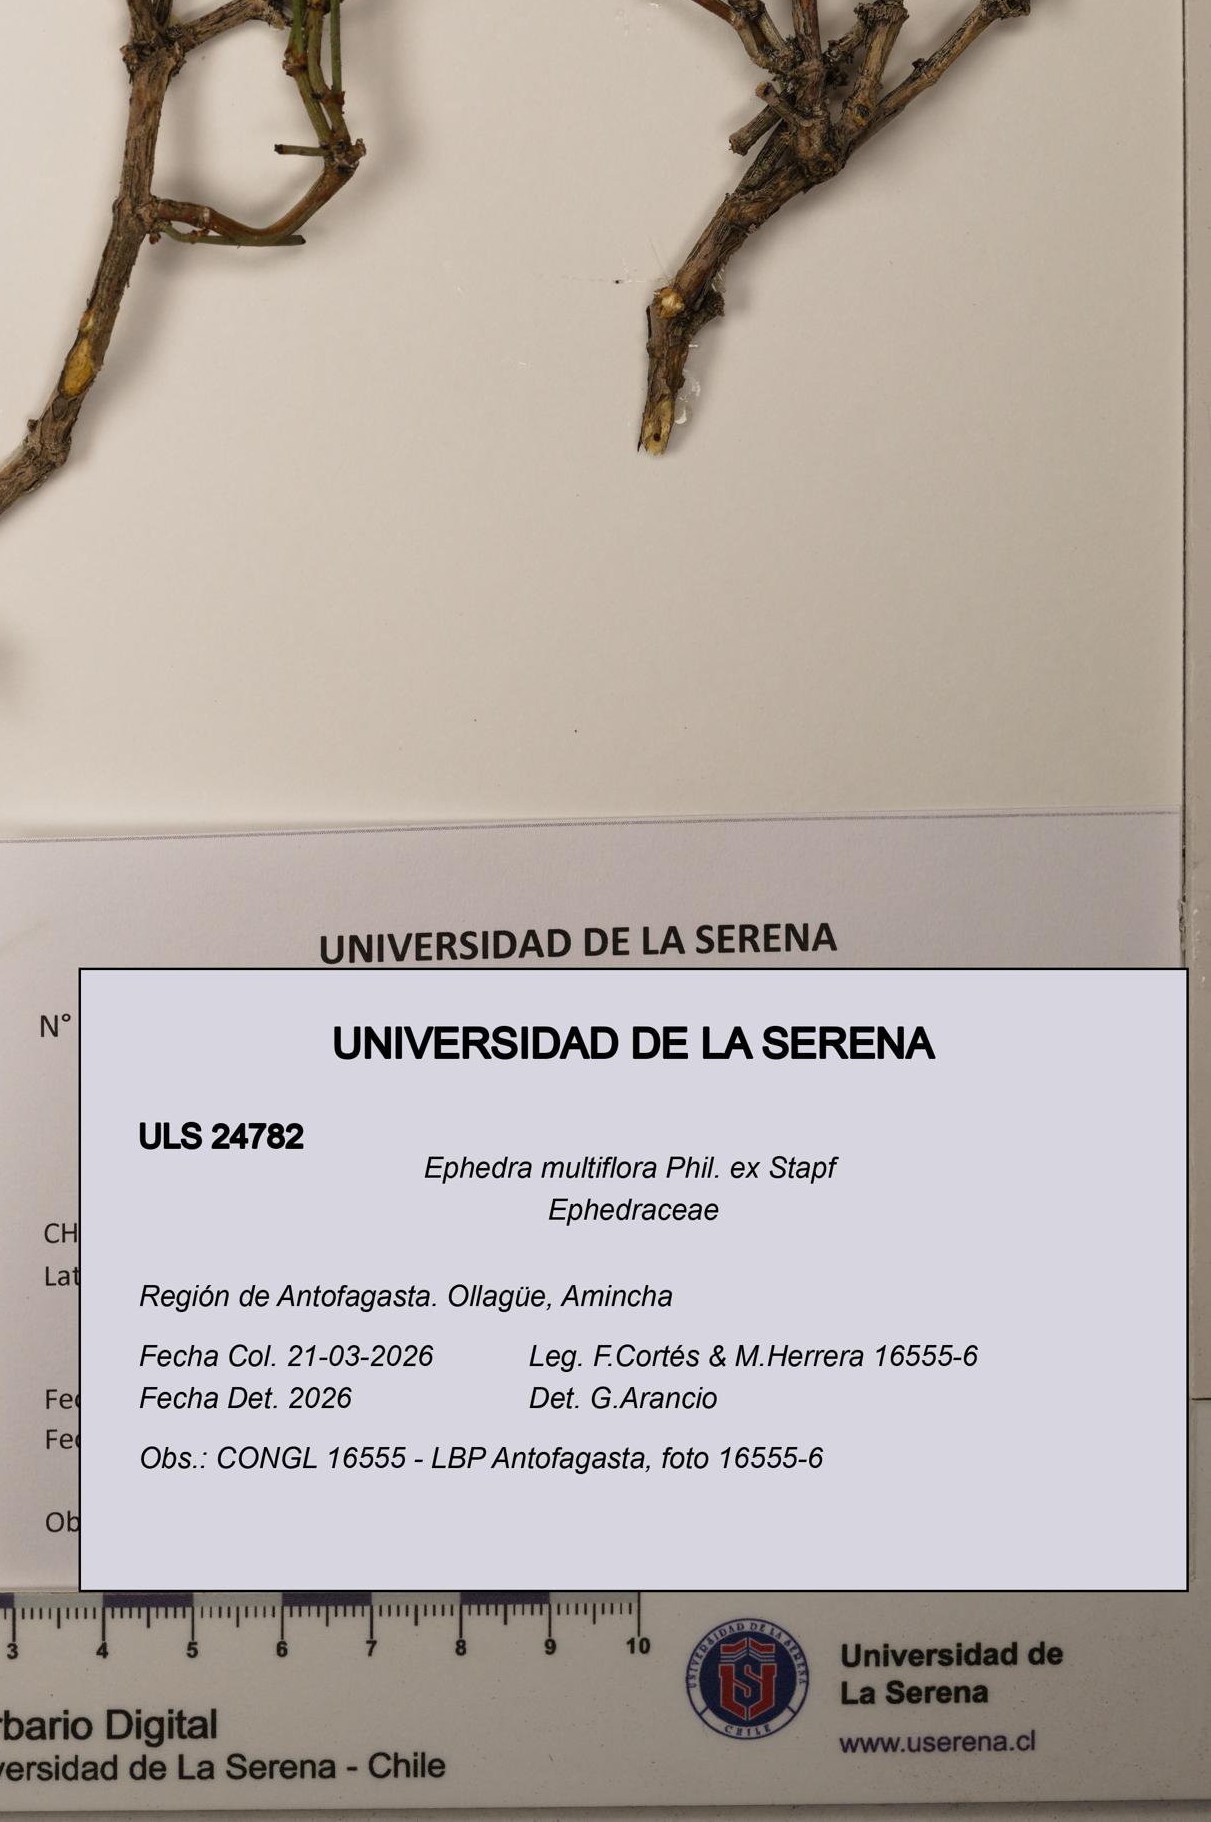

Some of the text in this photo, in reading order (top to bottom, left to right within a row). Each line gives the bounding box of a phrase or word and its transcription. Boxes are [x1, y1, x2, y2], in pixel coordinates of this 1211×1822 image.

[320, 922, 838, 965] UNIVERSIDAD DE LA SERENA
[40, 1013, 72, 1038] N°
[44, 1222, 78, 1244] CH
[7, 1643, 18, 1660] 3
[96, 1642, 108, 1658] 4
[186, 1642, 198, 1658] 5
[276, 1641, 288, 1657] 6
[366, 1640, 377, 1656] 7
[455, 1639, 467, 1656] 8
[544, 1638, 557, 1655] 9
[626, 1637, 651, 1654] 10
[688, 1622, 745, 1689] UNIVERSIDAD
[749, 1622, 767, 1632] DE
[841, 1640, 1064, 1668] Universidad de
[840, 1679, 989, 1706] La Serena
[106, 1708, 217, 1748] Digital
[724, 1723, 772, 1737] CHILE
[839, 1729, 1036, 1754] www.userena.cl
[128, 1753, 167, 1781] de
[177, 1753, 215, 1781] La
[225, 1752, 336, 1781] Serena
[368, 1751, 446, 1779] Chile
